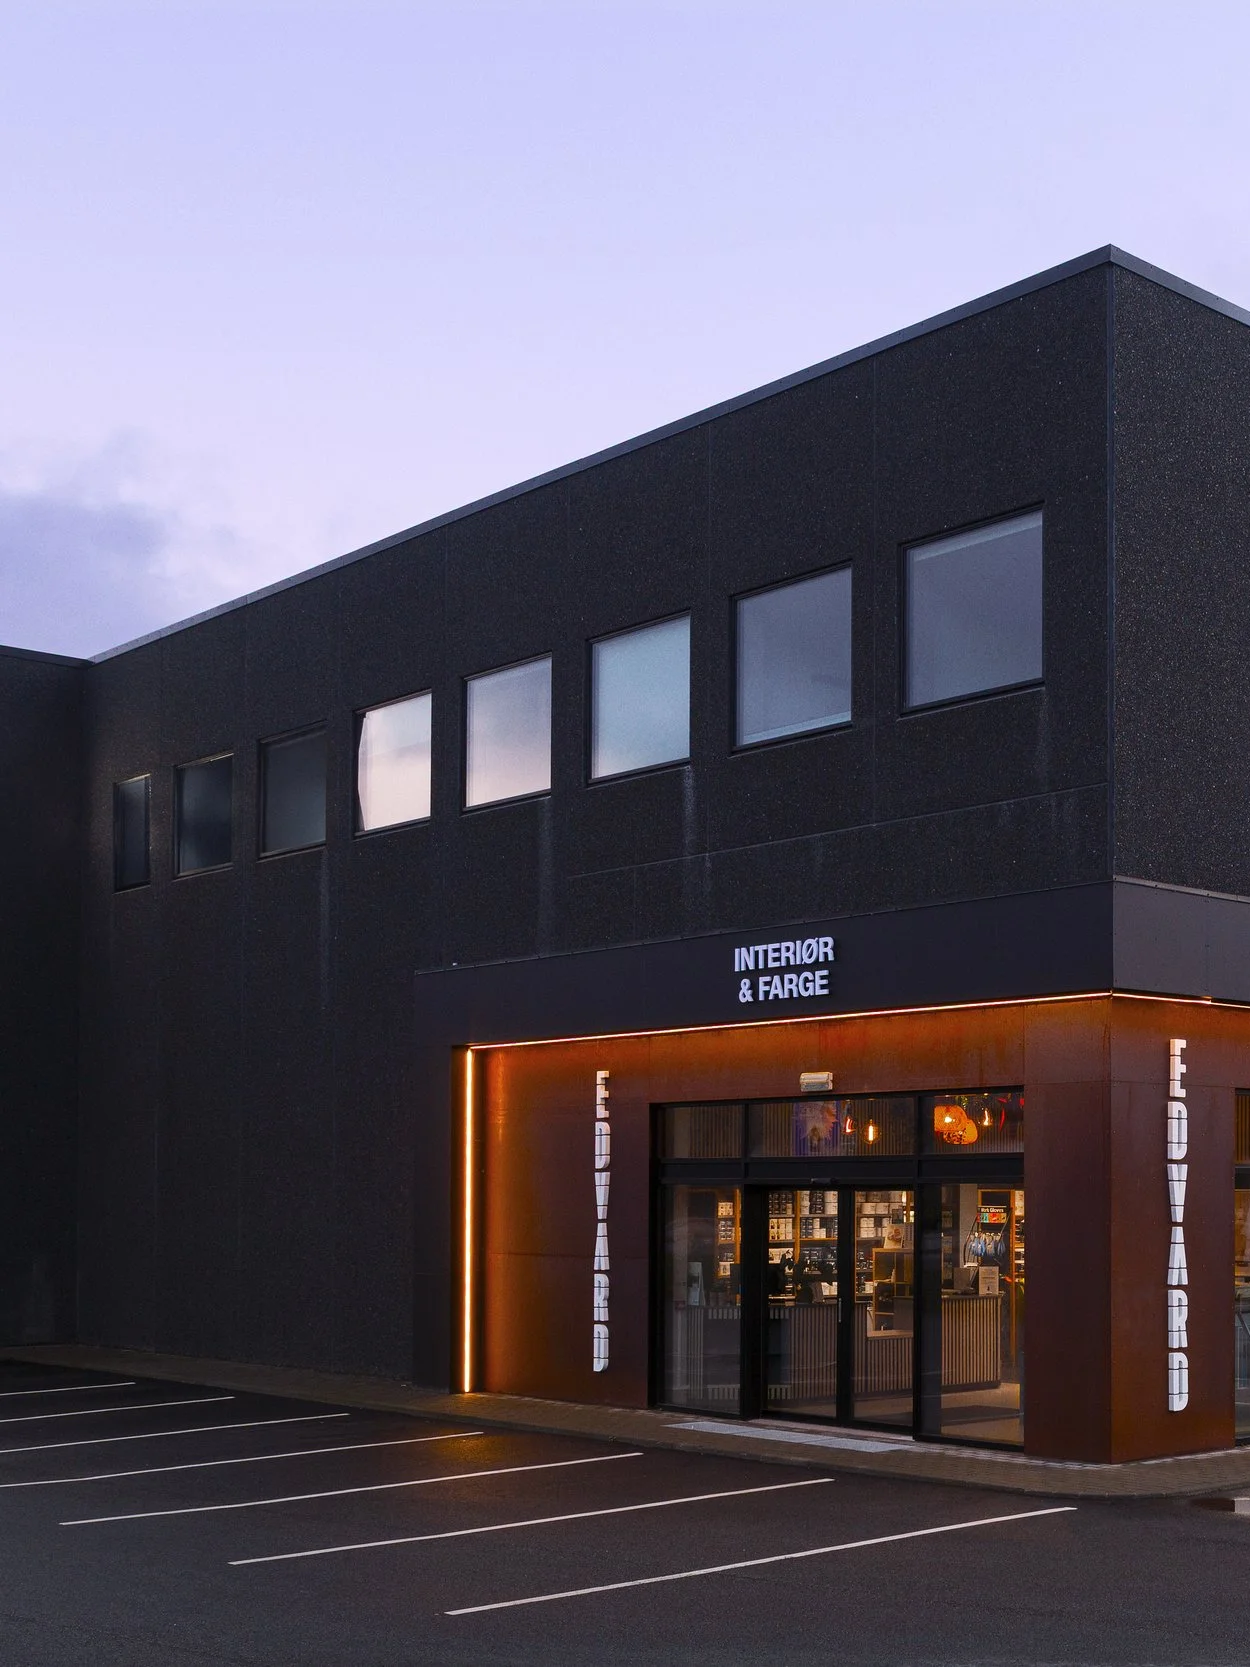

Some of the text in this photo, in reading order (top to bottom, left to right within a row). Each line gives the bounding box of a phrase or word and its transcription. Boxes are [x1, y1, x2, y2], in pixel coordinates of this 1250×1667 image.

[734, 936, 835, 972] INTERIØR
[738, 969, 830, 1003] & FARGE
[593, 1070, 611, 1372] EDVARD
[1167, 1038, 1188, 1412] EDVARD
